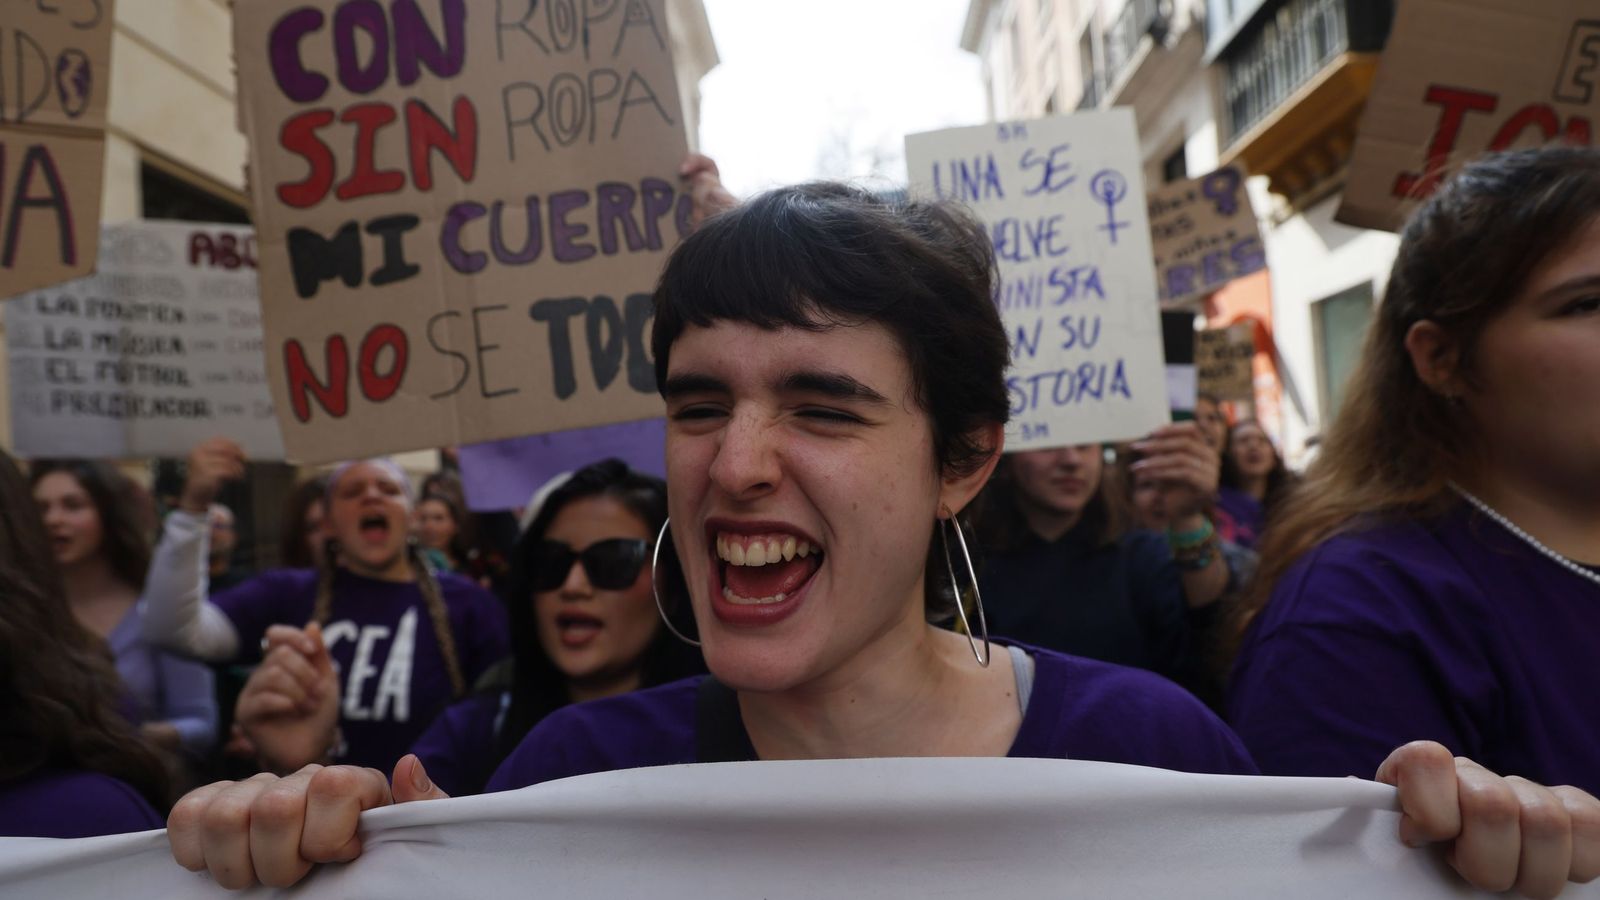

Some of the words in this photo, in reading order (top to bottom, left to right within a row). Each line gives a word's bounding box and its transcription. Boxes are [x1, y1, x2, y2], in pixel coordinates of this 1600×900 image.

[269, 0, 467, 102] CON
[495, 0, 666, 61] ROPA
[276, 95, 478, 208] SIN
[502, 68, 674, 161] ROPA
[932, 152, 1005, 202] UNA
[1019, 143, 1077, 197] SE
[0, 141, 77, 268] A
[286, 214, 420, 298] MI
[996, 265, 1106, 311] INISTA
[283, 323, 409, 423] NO
[427, 305, 519, 399] SE
[529, 293, 657, 401] TOC
[1060, 315, 1101, 350] SU
[1006, 358, 1132, 415] STORIA
